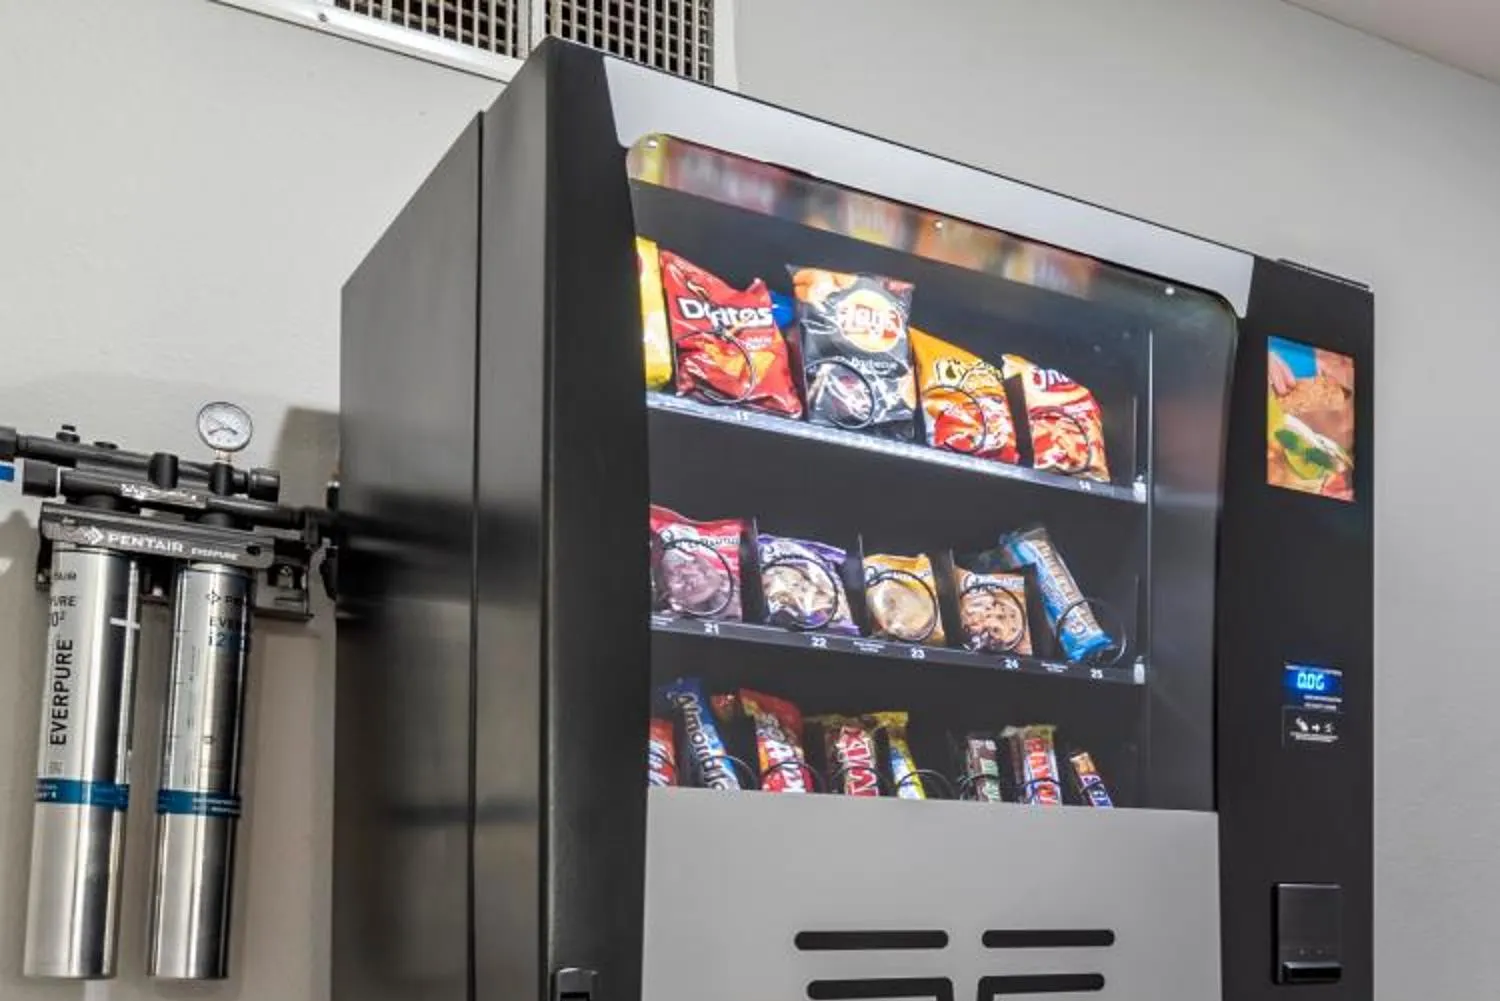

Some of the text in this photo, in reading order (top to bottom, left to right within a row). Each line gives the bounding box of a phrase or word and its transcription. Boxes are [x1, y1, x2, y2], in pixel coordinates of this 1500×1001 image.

[108, 531, 184, 553] PENTAIR
[704, 623, 719, 635] 21
[50, 638, 73, 746] EVERPURE
